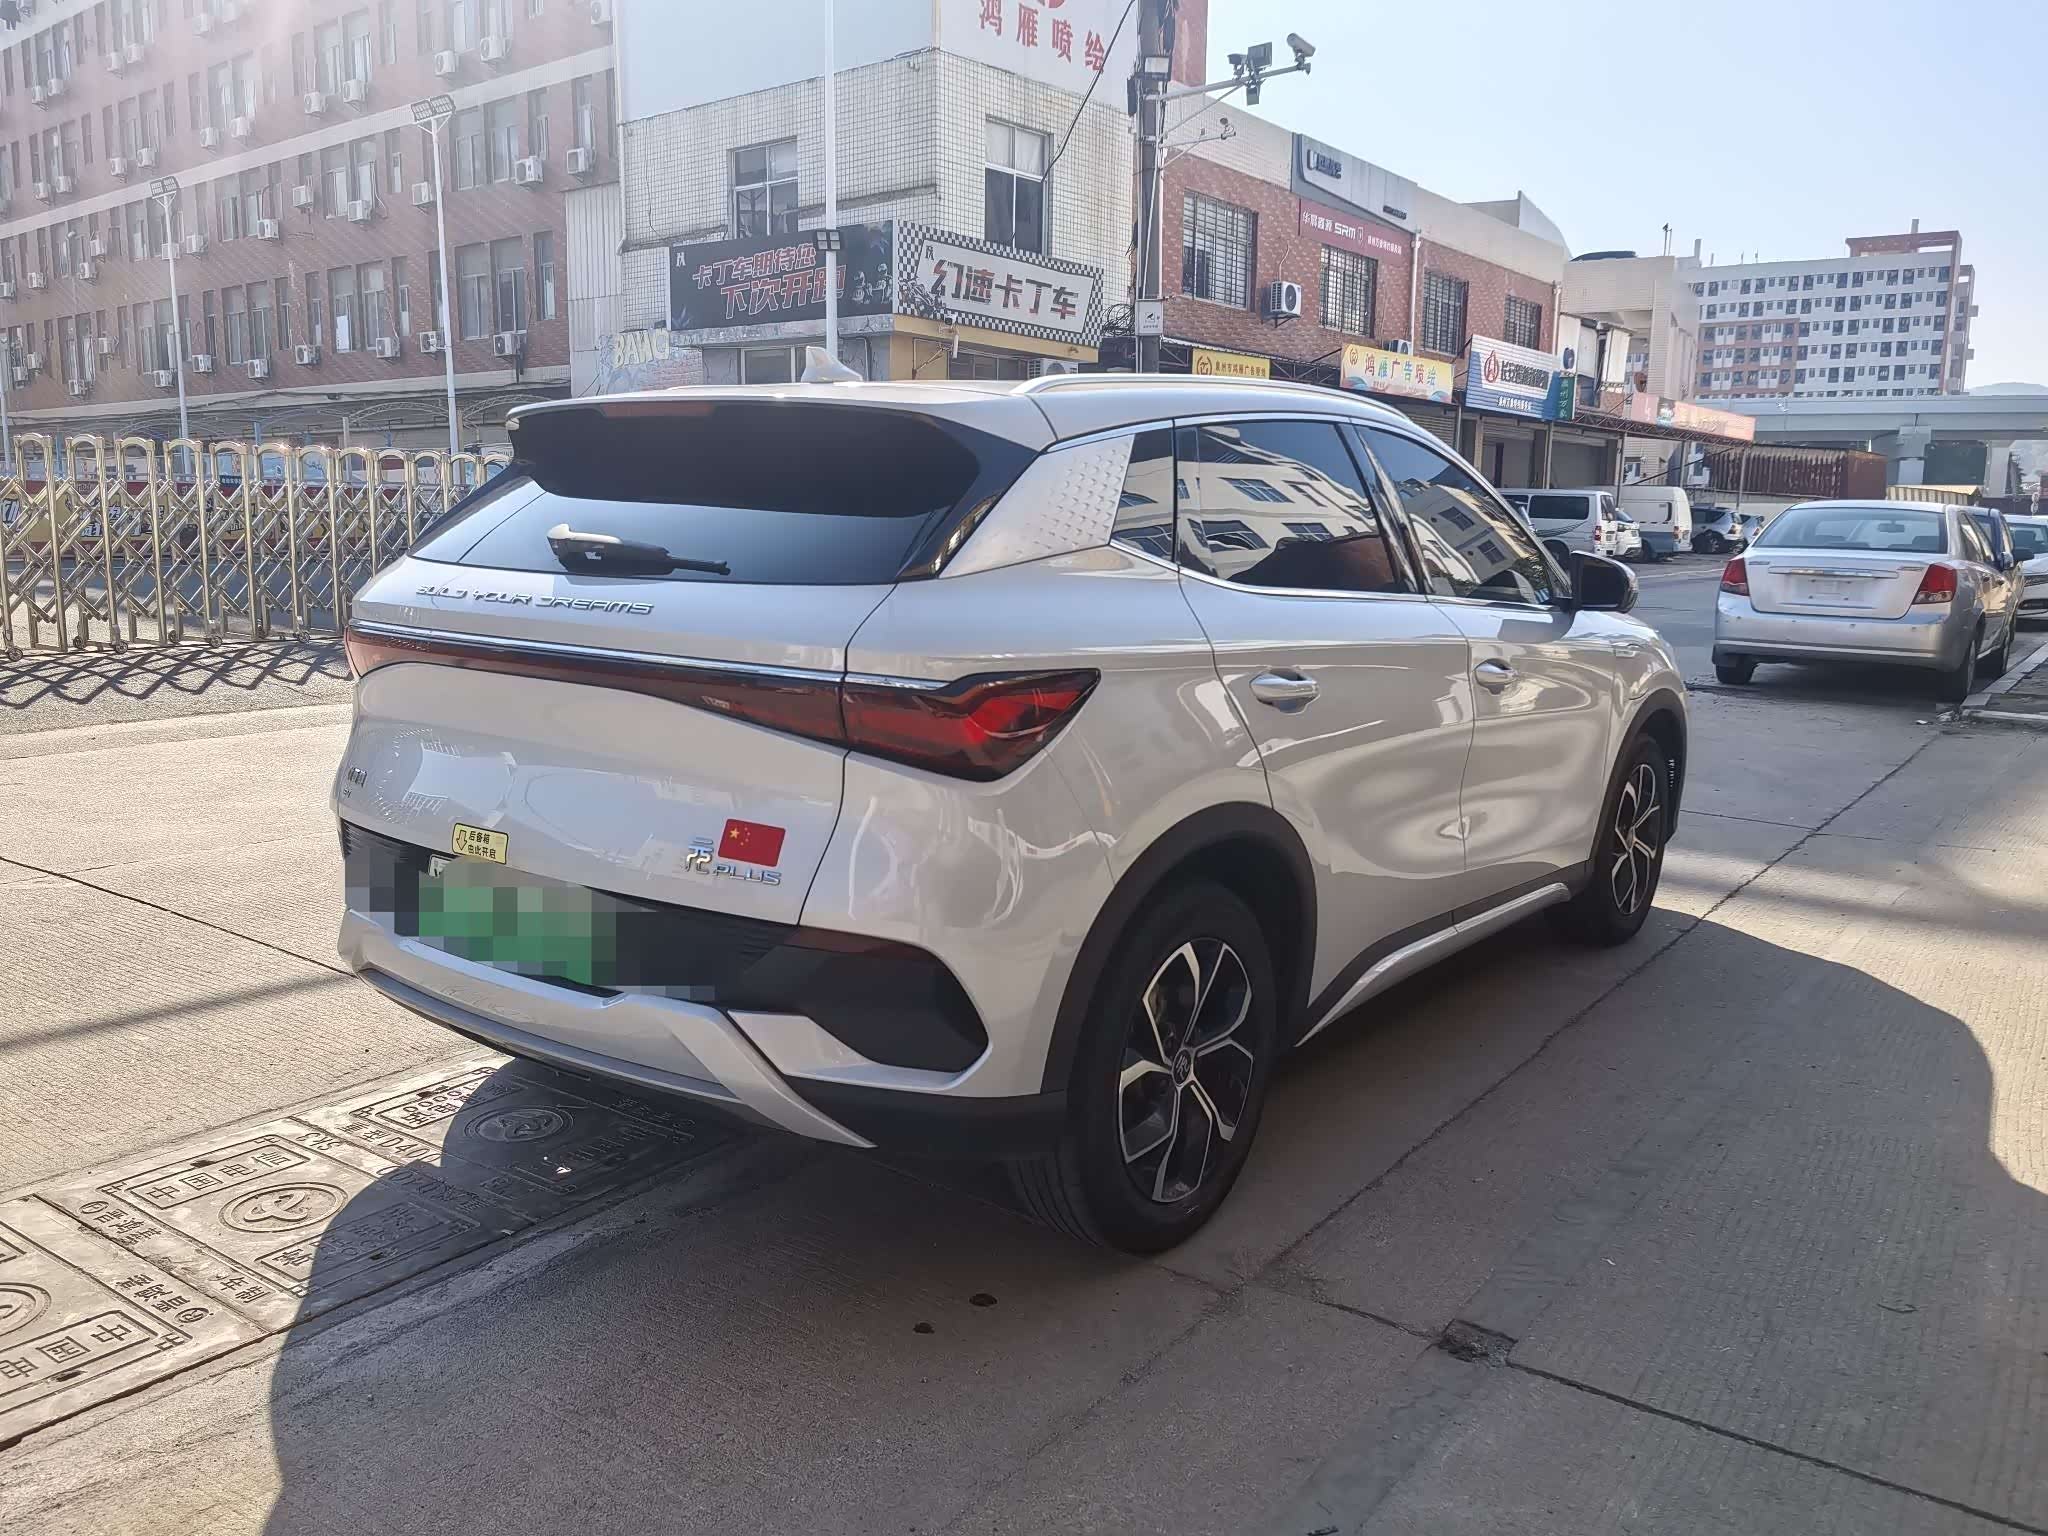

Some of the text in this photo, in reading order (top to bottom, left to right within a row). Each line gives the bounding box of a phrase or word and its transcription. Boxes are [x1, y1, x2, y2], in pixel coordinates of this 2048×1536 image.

[979, 0, 1105, 74] 鸿雁喷绘
[1334, 222, 1357, 240] SRM
[692, 242, 817, 289] 卡丁车期待您
[721, 264, 847, 320] 下次开跑
[930, 259, 1079, 320] 幻速卡丁车
[472, 589, 534, 606] YOUR
[535, 594, 655, 615] DREAMS
[468, 830, 490, 845] 后备箱
[712, 863, 782, 886] PLUS
[147, 1150, 293, 1201] 中国电信
